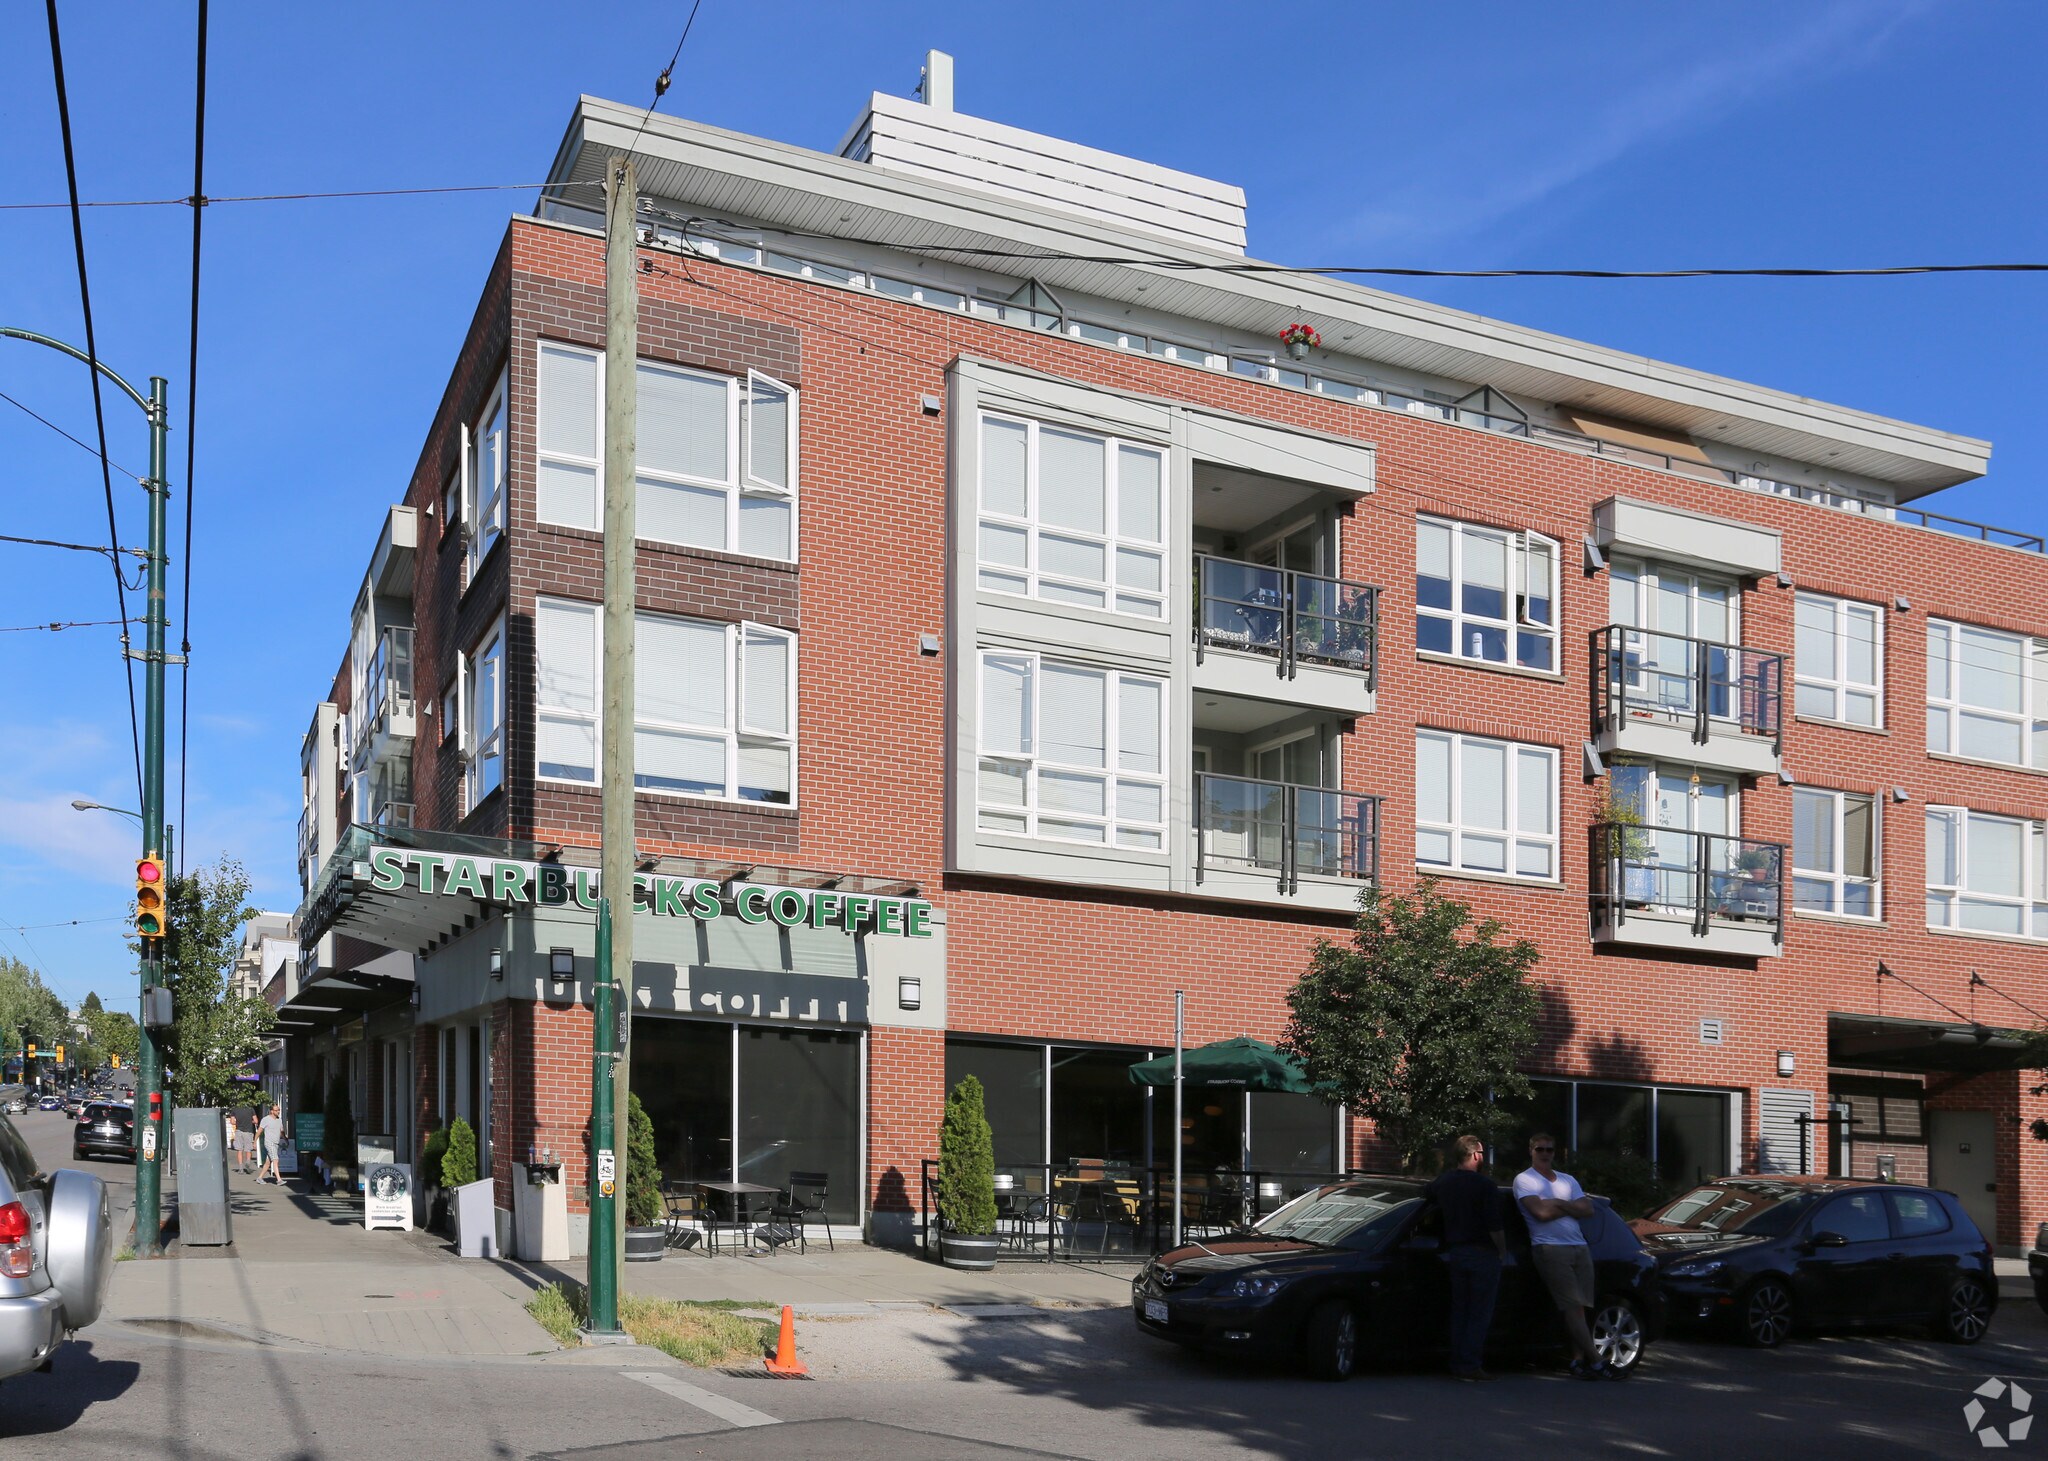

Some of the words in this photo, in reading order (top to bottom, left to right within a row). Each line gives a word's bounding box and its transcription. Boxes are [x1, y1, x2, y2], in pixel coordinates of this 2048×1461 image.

[737, 884, 933, 938] COFFEE
[371, 1168, 404, 1184] STARBUCKS
[376, 1191, 402, 1202] COFFEE
